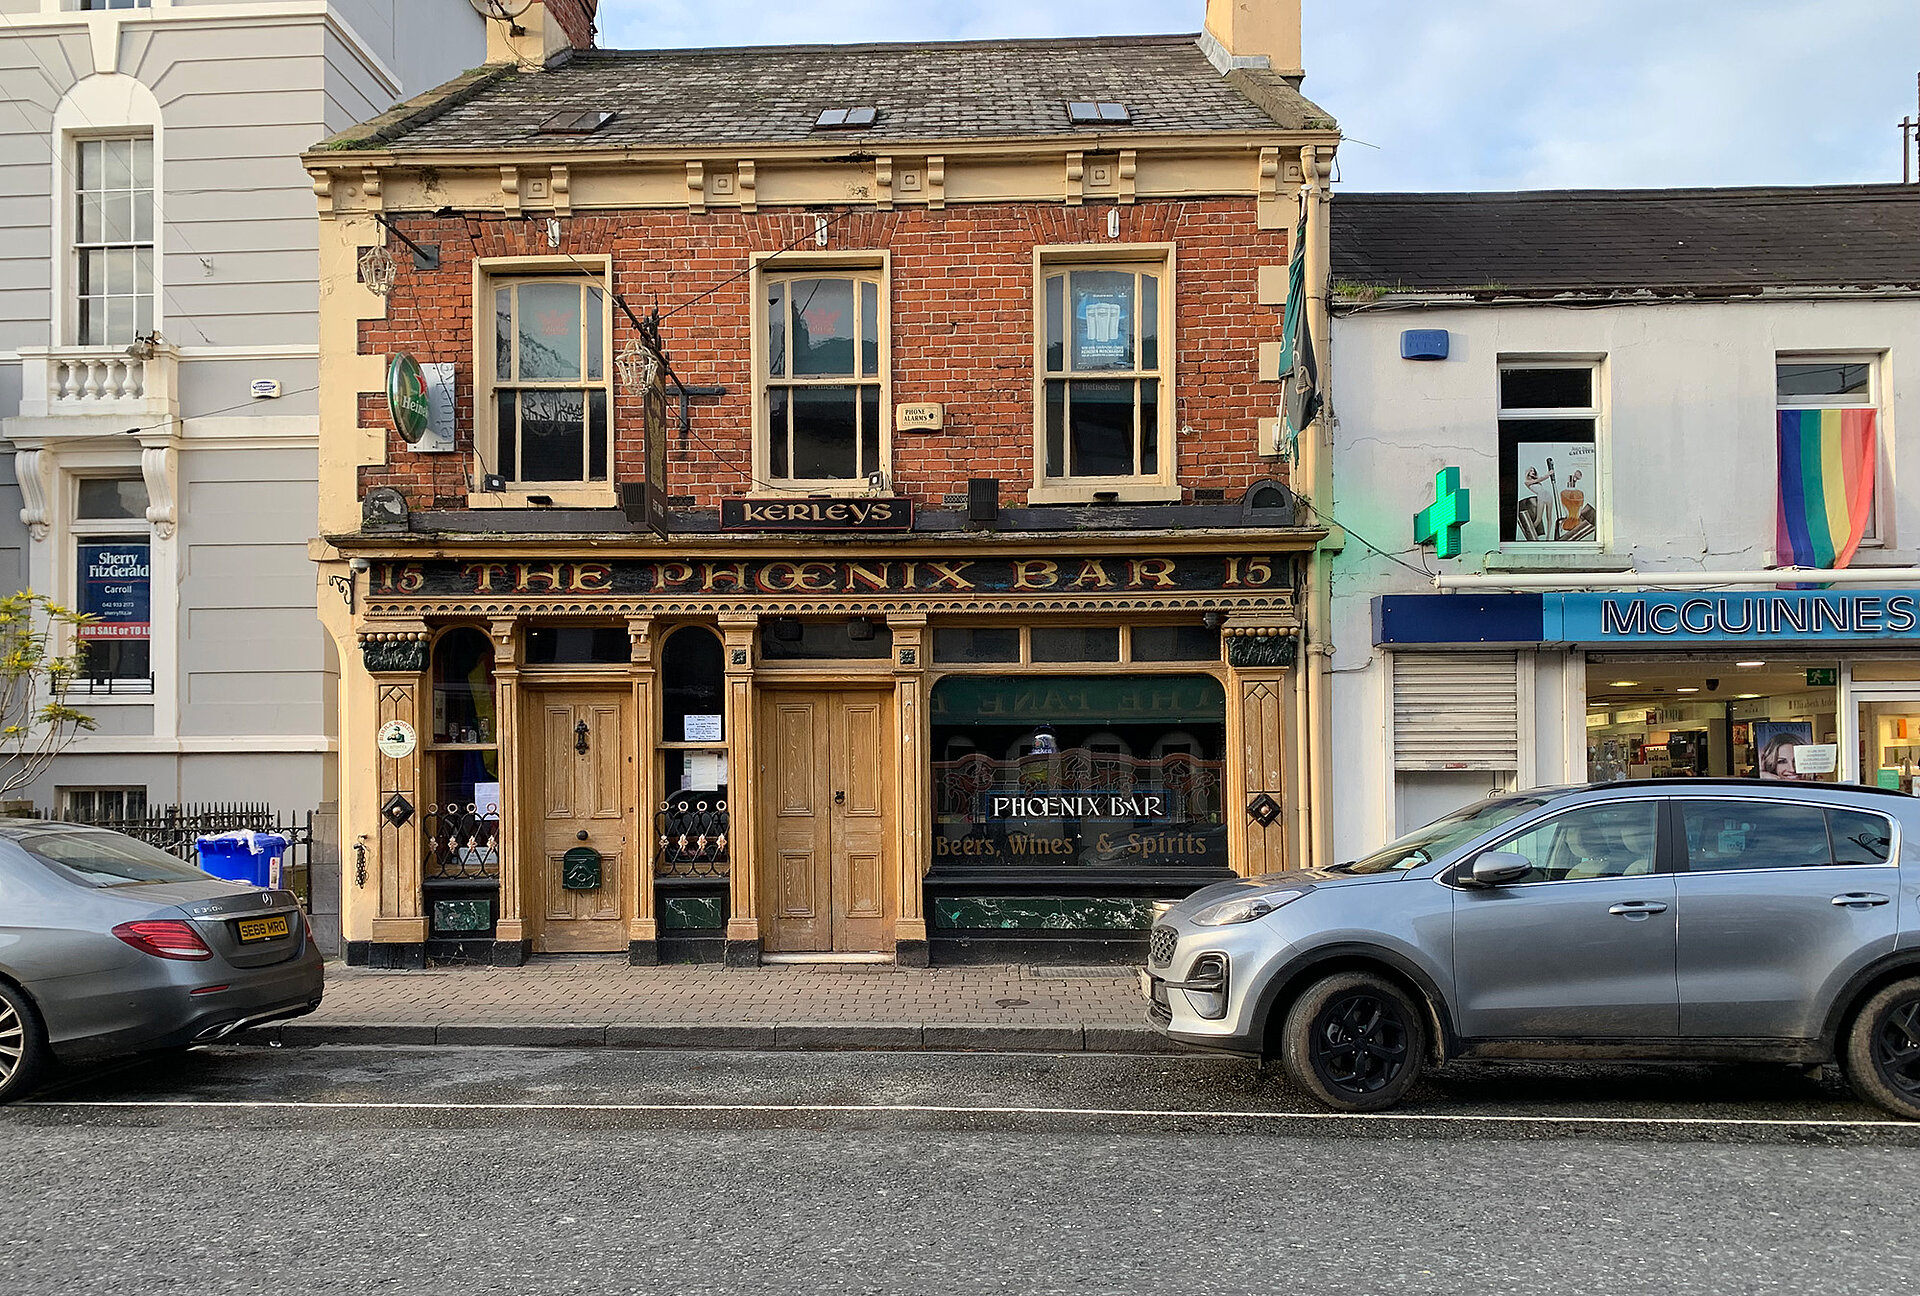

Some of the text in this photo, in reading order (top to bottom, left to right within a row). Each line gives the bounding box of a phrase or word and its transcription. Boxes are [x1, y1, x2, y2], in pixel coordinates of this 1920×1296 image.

[1082, 383, 1121, 391] Heineken
[99, 552, 138, 567] Sherry
[89, 564, 149, 577] FitzGerald
[377, 562, 426, 592] 15
[461, 562, 615, 594] THE
[1009, 558, 1182, 591] BAR
[1223, 556, 1273, 588] 15
[104, 585, 132, 594] Carroll
[1601, 596, 1917, 634] McGUINNES
[80, 627, 96, 635] FOR
[97, 627, 117, 635] SALE
[119, 627, 128, 635] or
[130, 627, 141, 635] TO
[379, 722, 394, 741] BIRRA
[1111, 797, 1163, 816] BAR
[935, 832, 1207, 858] Beers, Wines & Spirits
[241, 920, 286, 937] SE66 MRO
